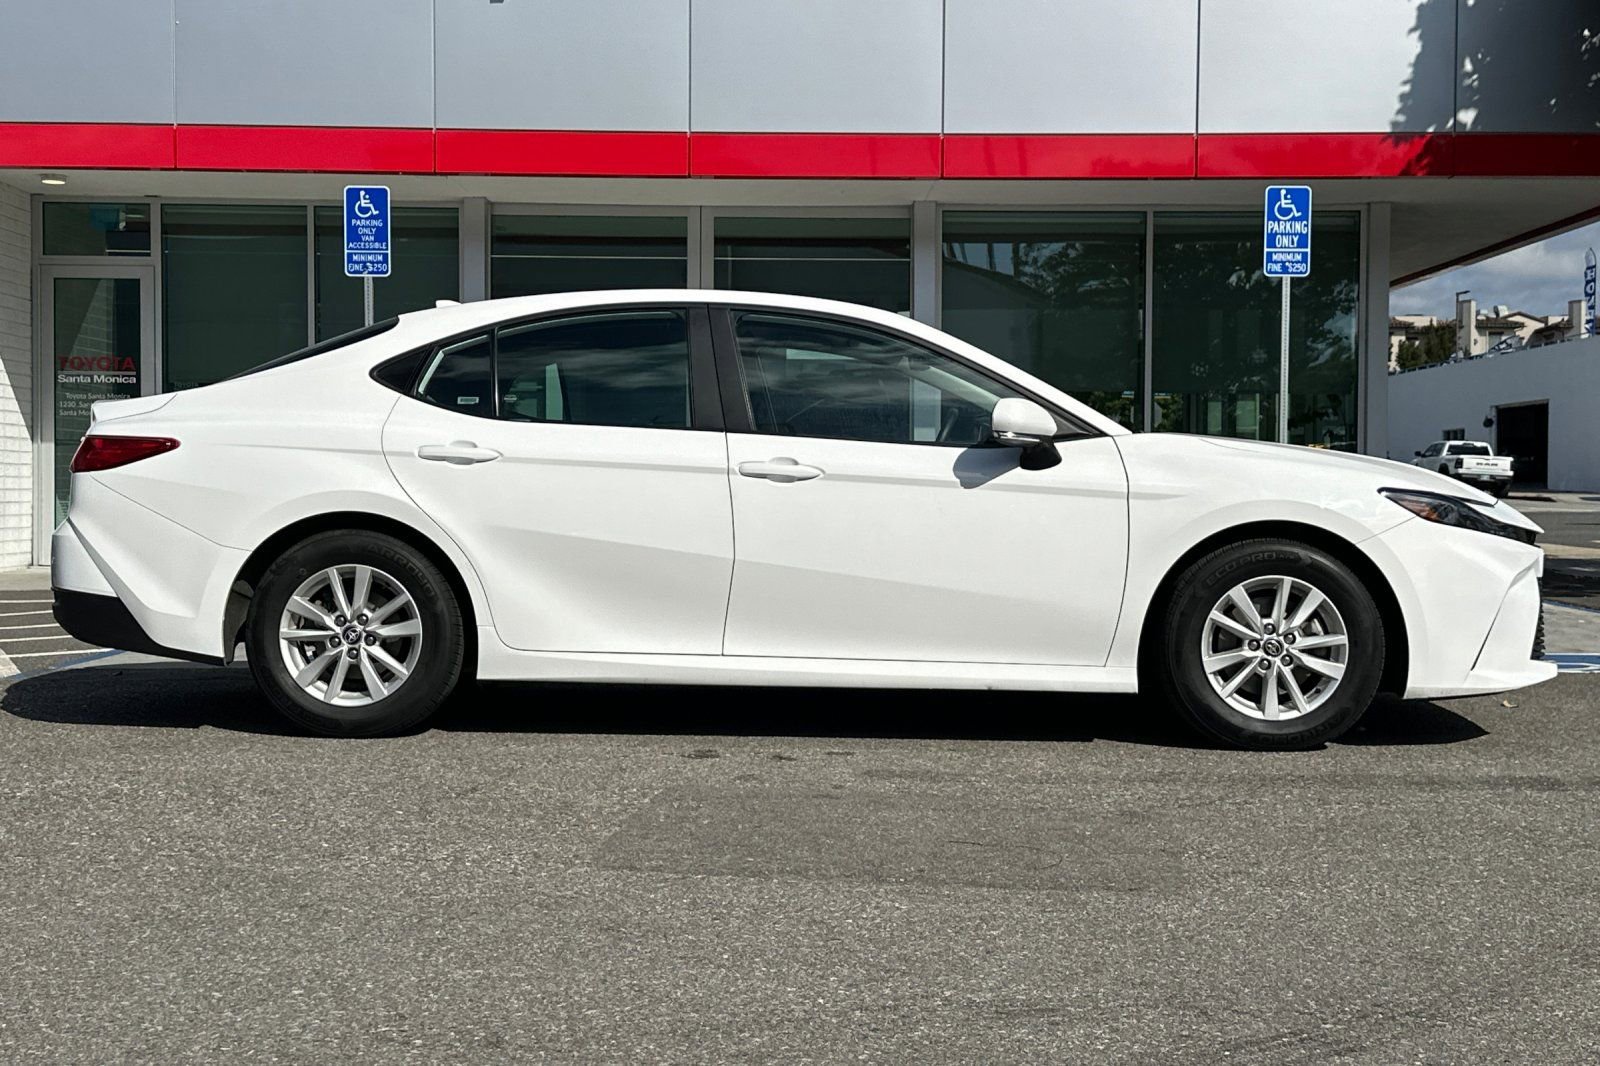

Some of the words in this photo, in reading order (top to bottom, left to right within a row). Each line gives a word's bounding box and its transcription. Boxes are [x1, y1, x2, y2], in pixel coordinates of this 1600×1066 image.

[357, 227, 377, 235] ONLY
[1267, 221, 1308, 234] PARKING
[1275, 235, 1299, 248] ONLY
[352, 254, 383, 262] MINIMUM
[1272, 253, 1302, 262] MINIMUM
[1267, 263, 1283, 272] FINE
[1287, 263, 1307, 272] $250
[57, 355, 136, 370] TOYOTA
[57, 374, 91, 383] Santa
[93, 374, 136, 384] Monica
[65, 392, 87, 401] Toyota
[88, 392, 106, 400] Santa
